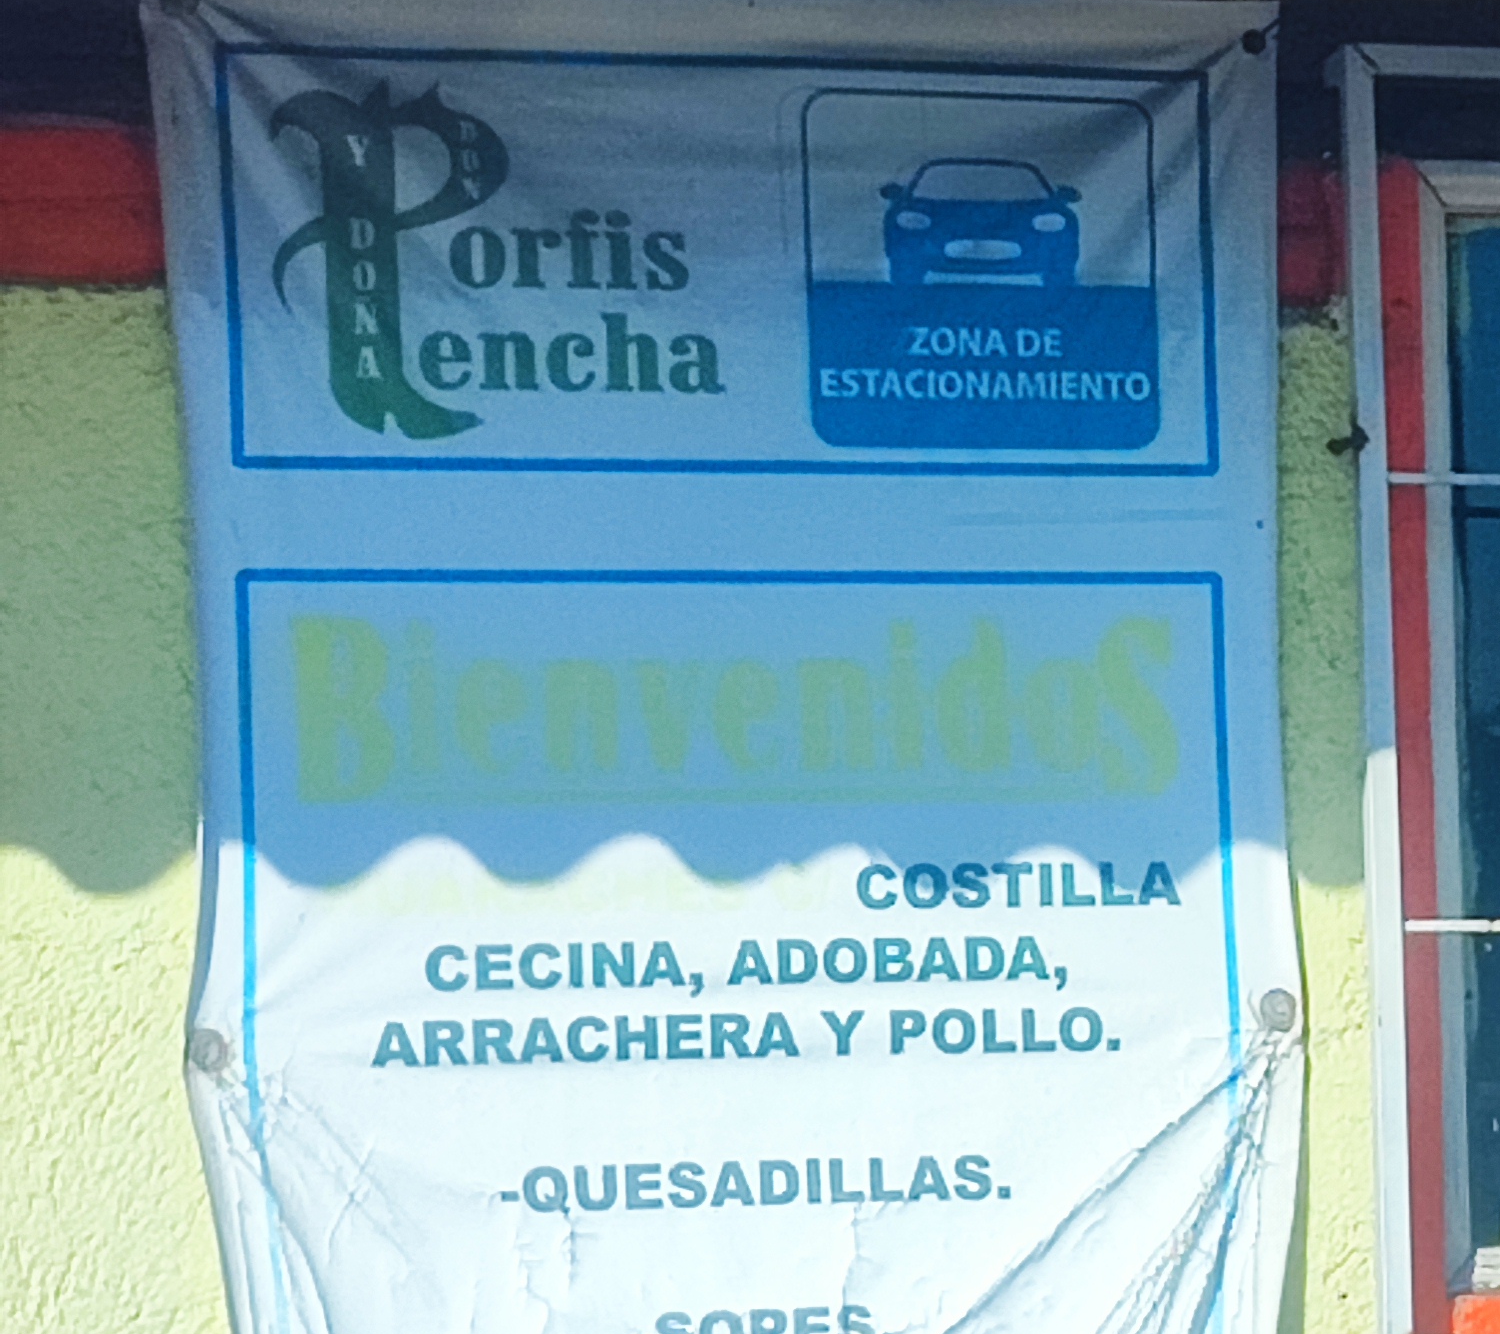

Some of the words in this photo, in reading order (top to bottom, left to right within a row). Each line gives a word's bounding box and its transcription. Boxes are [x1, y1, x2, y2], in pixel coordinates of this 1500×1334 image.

[347, 132, 369, 168] Y
[906, 326, 1008, 357] ZONA
[1016, 327, 1064, 357] DE
[820, 367, 1151, 401] ESTACIONAMIENTO
[855, 860, 1182, 910] COSTILLA
[424, 940, 706, 997] CECINA,
[726, 935, 1068, 991] ADOBADA,
[371, 1012, 800, 1068] ARRACHERA
[821, 1010, 865, 1056] Y
[890, 1006, 1122, 1055] POLLO.
[500, 1154, 1012, 1214] -QUESADILLAS.
